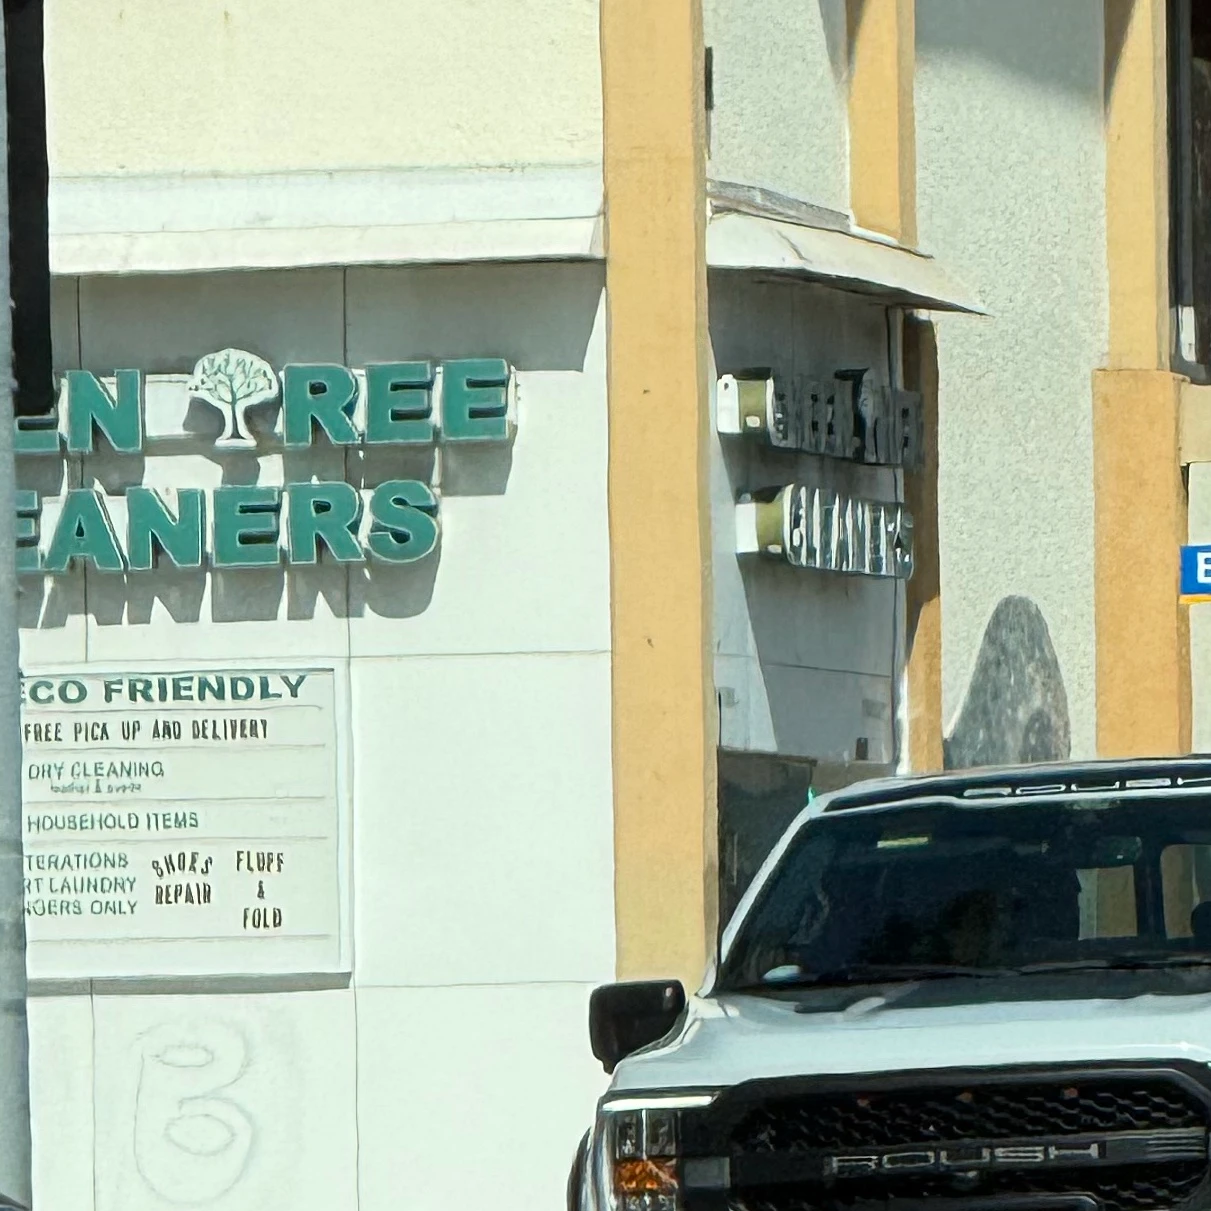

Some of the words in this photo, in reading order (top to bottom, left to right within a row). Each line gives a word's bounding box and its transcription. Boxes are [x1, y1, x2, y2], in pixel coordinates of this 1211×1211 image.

[103, 675, 307, 703] FRIENDLY
[24, 722, 63, 742] FREE
[74, 721, 109, 742] PICK
[121, 719, 141, 741] UP
[152, 718, 181, 741] AND
[191, 718, 268, 741] DELIVERY
[28, 761, 65, 780] DRY
[70, 760, 165, 779] CLEANING
[27, 812, 140, 834] HOUSEHOLD
[146, 812, 199, 831] ITEMS
[151, 851, 213, 879] SHOES
[236, 850, 284, 873] FLUFF
[49, 876, 136, 895] LAUNDRY
[155, 882, 211, 905] REPAIR
[90, 899, 138, 916] ONLY
[243, 907, 282, 930] FOLD
[826, 1143, 1099, 1176] ROUSH
